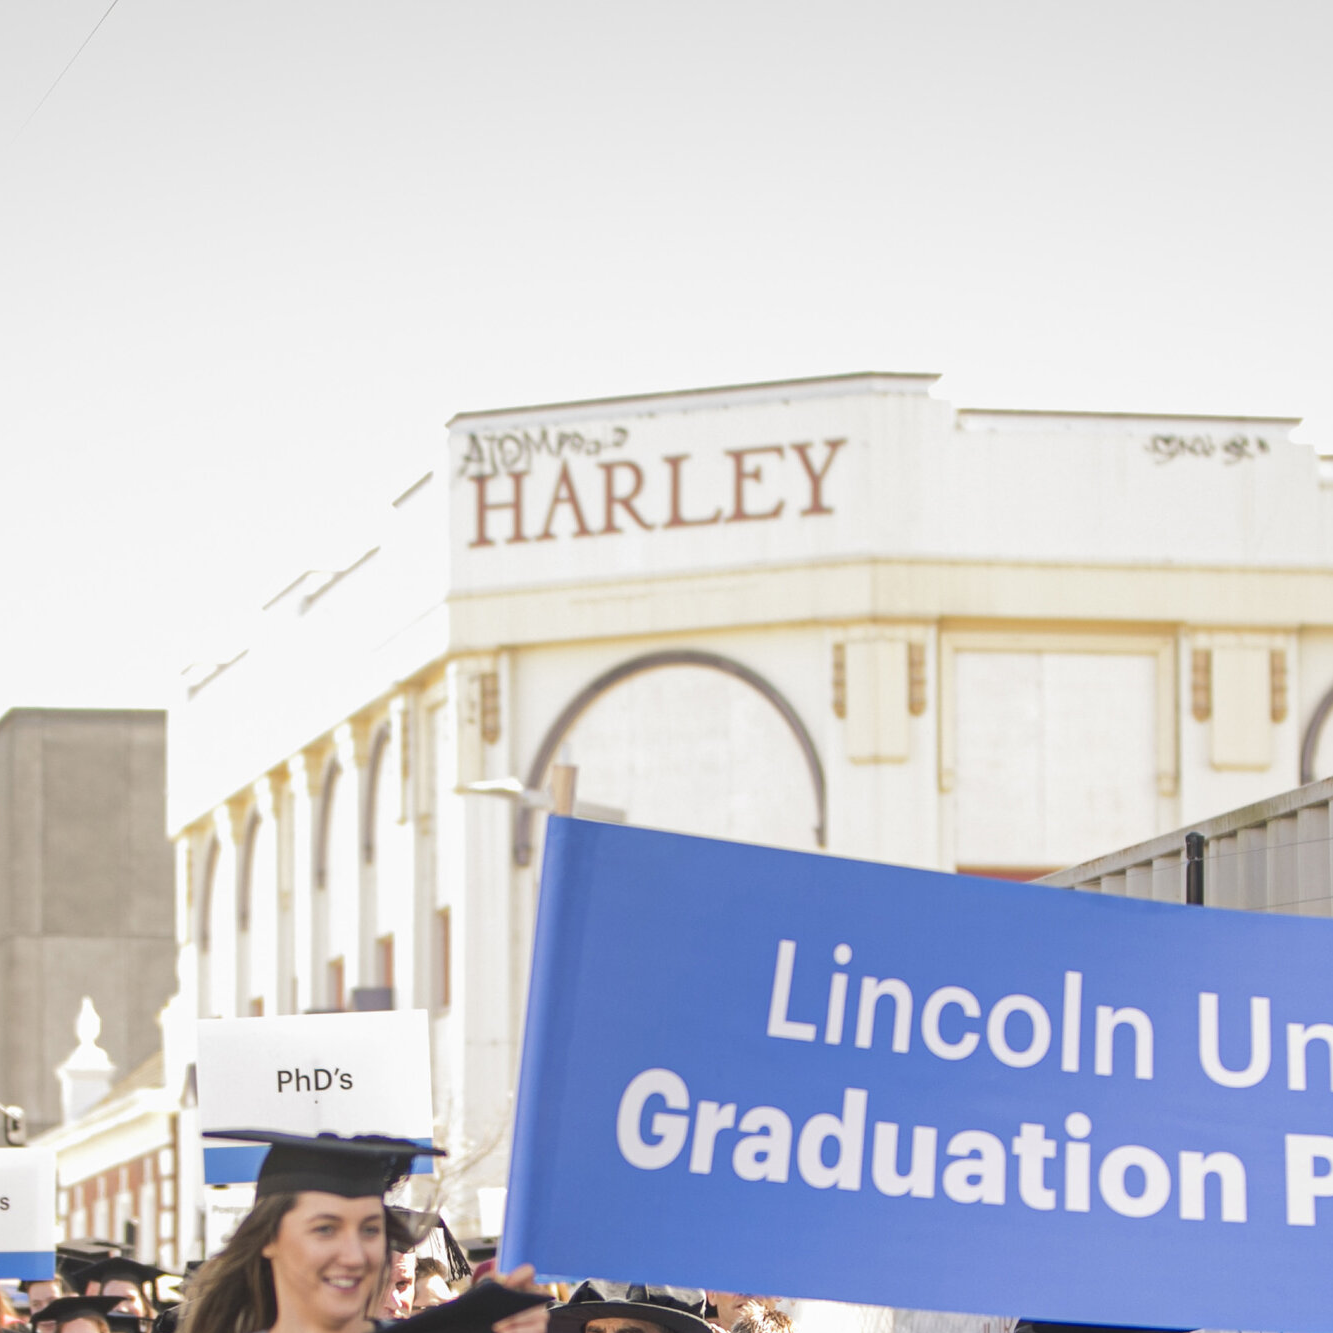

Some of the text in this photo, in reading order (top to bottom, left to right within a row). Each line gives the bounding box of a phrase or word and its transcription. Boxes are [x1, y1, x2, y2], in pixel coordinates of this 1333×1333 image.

[468, 439, 848, 549] HARLEY
[767, 940, 1154, 1080] Lincoln
[277, 1068, 354, 1093] PhD's
[616, 1067, 1248, 1223] Graduation
